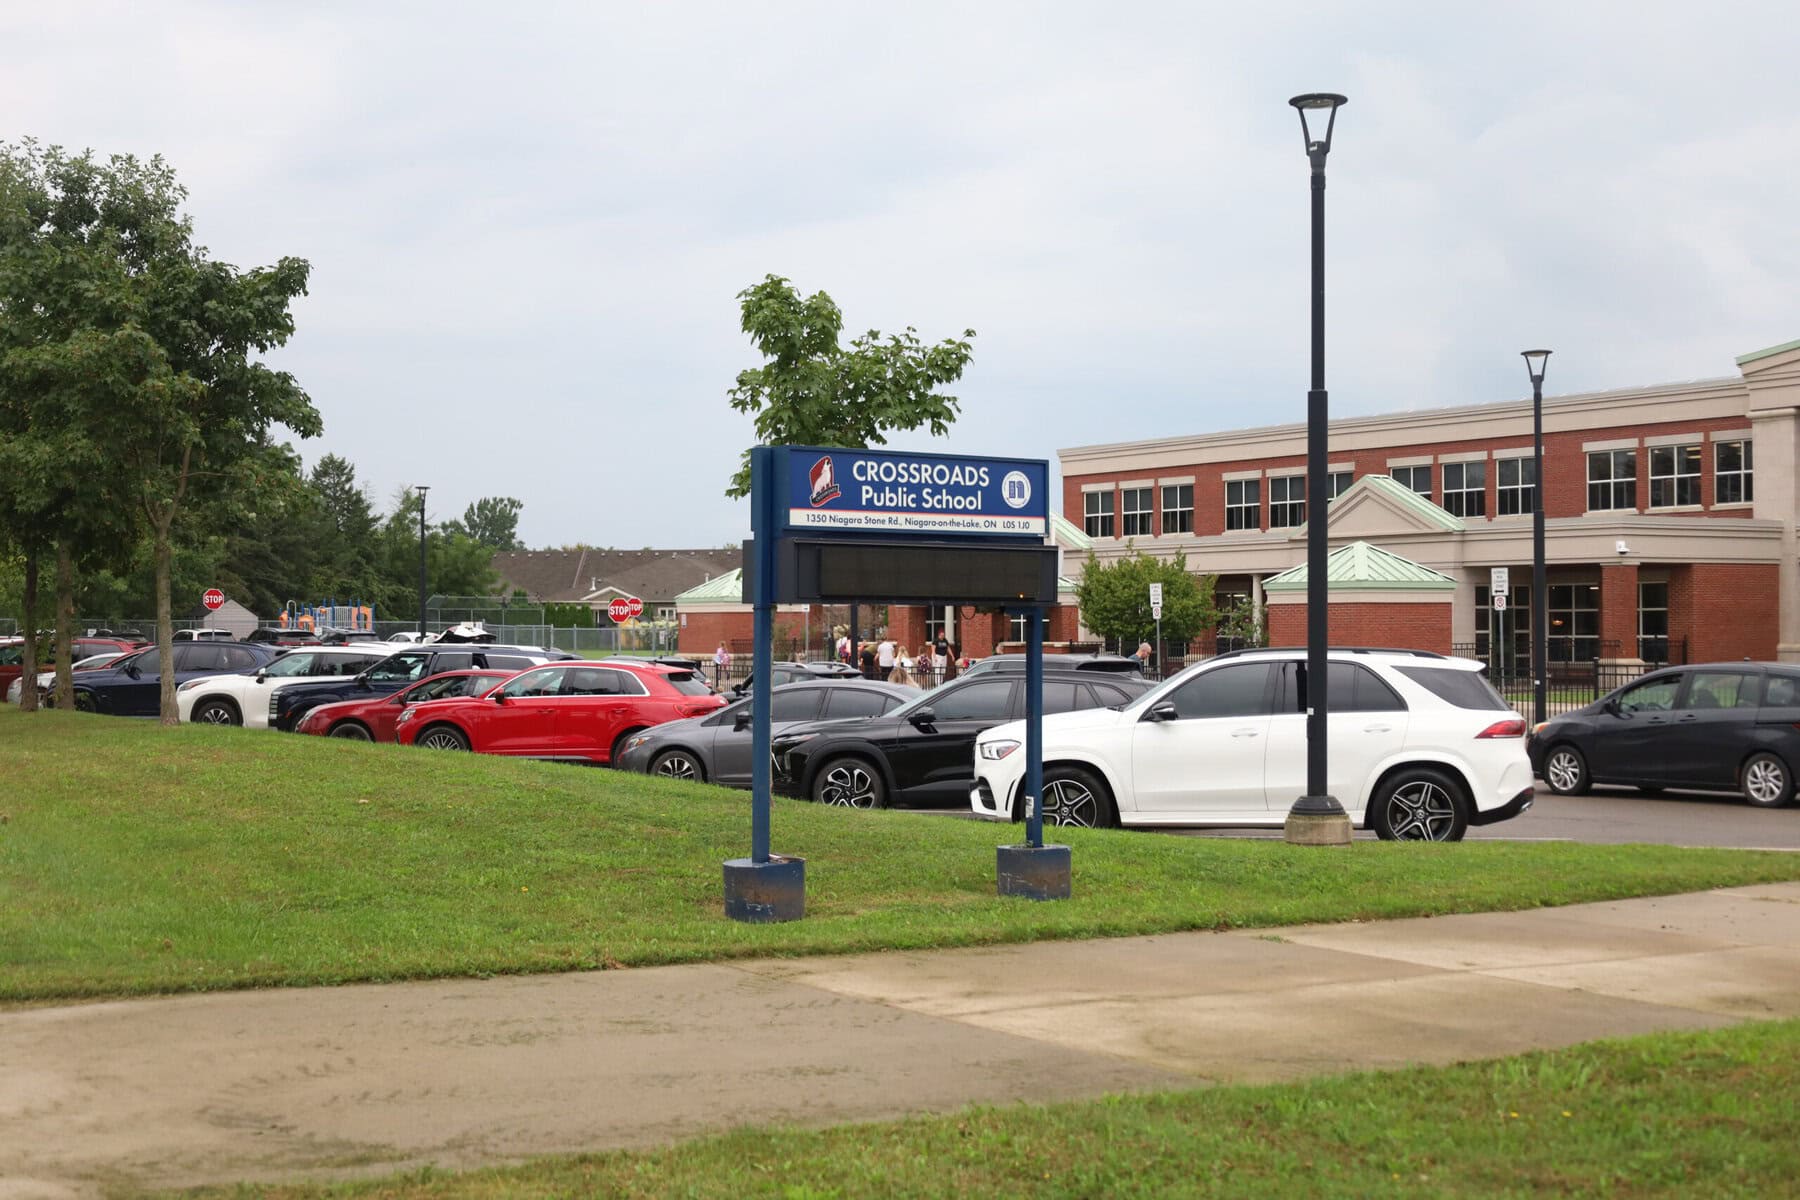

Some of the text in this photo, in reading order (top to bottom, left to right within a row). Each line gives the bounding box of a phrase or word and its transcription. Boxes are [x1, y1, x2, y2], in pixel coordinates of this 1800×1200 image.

[852, 460, 990, 487] CROSSROADS
[861, 485, 917, 508] Public
[921, 487, 982, 510] School
[806, 513, 827, 523] 1350
[829, 514, 863, 526] Niagara
[864, 515, 886, 525] Stone
[983, 519, 997, 529] ON
[205, 595, 223, 604] STOP
[610, 606, 629, 615] STOP
